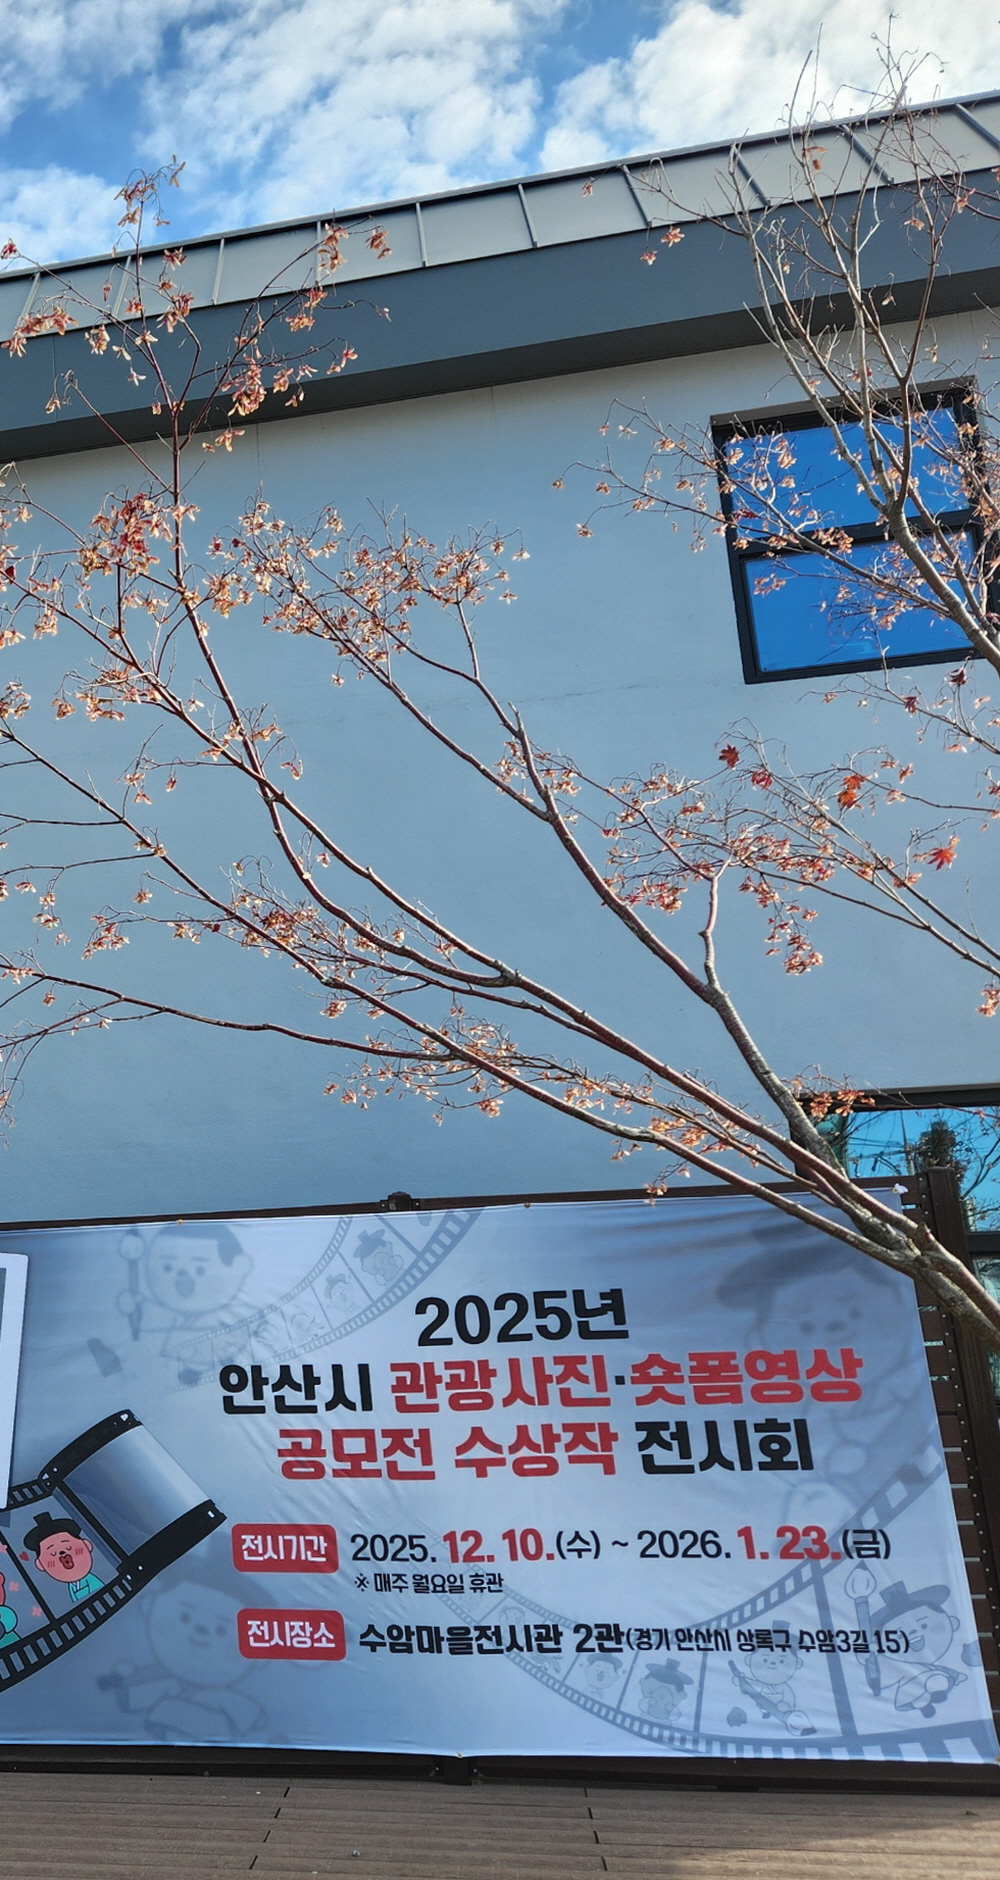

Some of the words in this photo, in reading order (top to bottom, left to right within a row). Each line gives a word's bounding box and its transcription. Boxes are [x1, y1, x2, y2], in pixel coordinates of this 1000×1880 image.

[415, 1288, 630, 1346] 2025년
[219, 1363, 373, 1415] 안산시
[277, 1427, 436, 1481] 공모전
[454, 1422, 619, 1478] 수상작
[635, 1418, 814, 1475] 전시회
[240, 1534, 328, 1562] 전시기간
[350, 1533, 437, 1563] 2025.
[442, 1529, 495, 1564] 12.
[611, 1538, 629, 1548] ~
[637, 1529, 731, 1560] 2026.
[736, 1525, 770, 1560] 1.
[373, 1573, 409, 1593] 매주
[412, 1573, 465, 1594] 월요일
[469, 1572, 504, 1594] 휴관
[247, 1620, 336, 1648] 전시장소
[359, 1623, 563, 1656] 수암마을전시관
[674, 1628, 731, 1652] 안산시
[736, 1628, 792, 1653] 상록구
[798, 1629, 871, 1654] 수암3길
[873, 1629, 911, 1654] 15)
